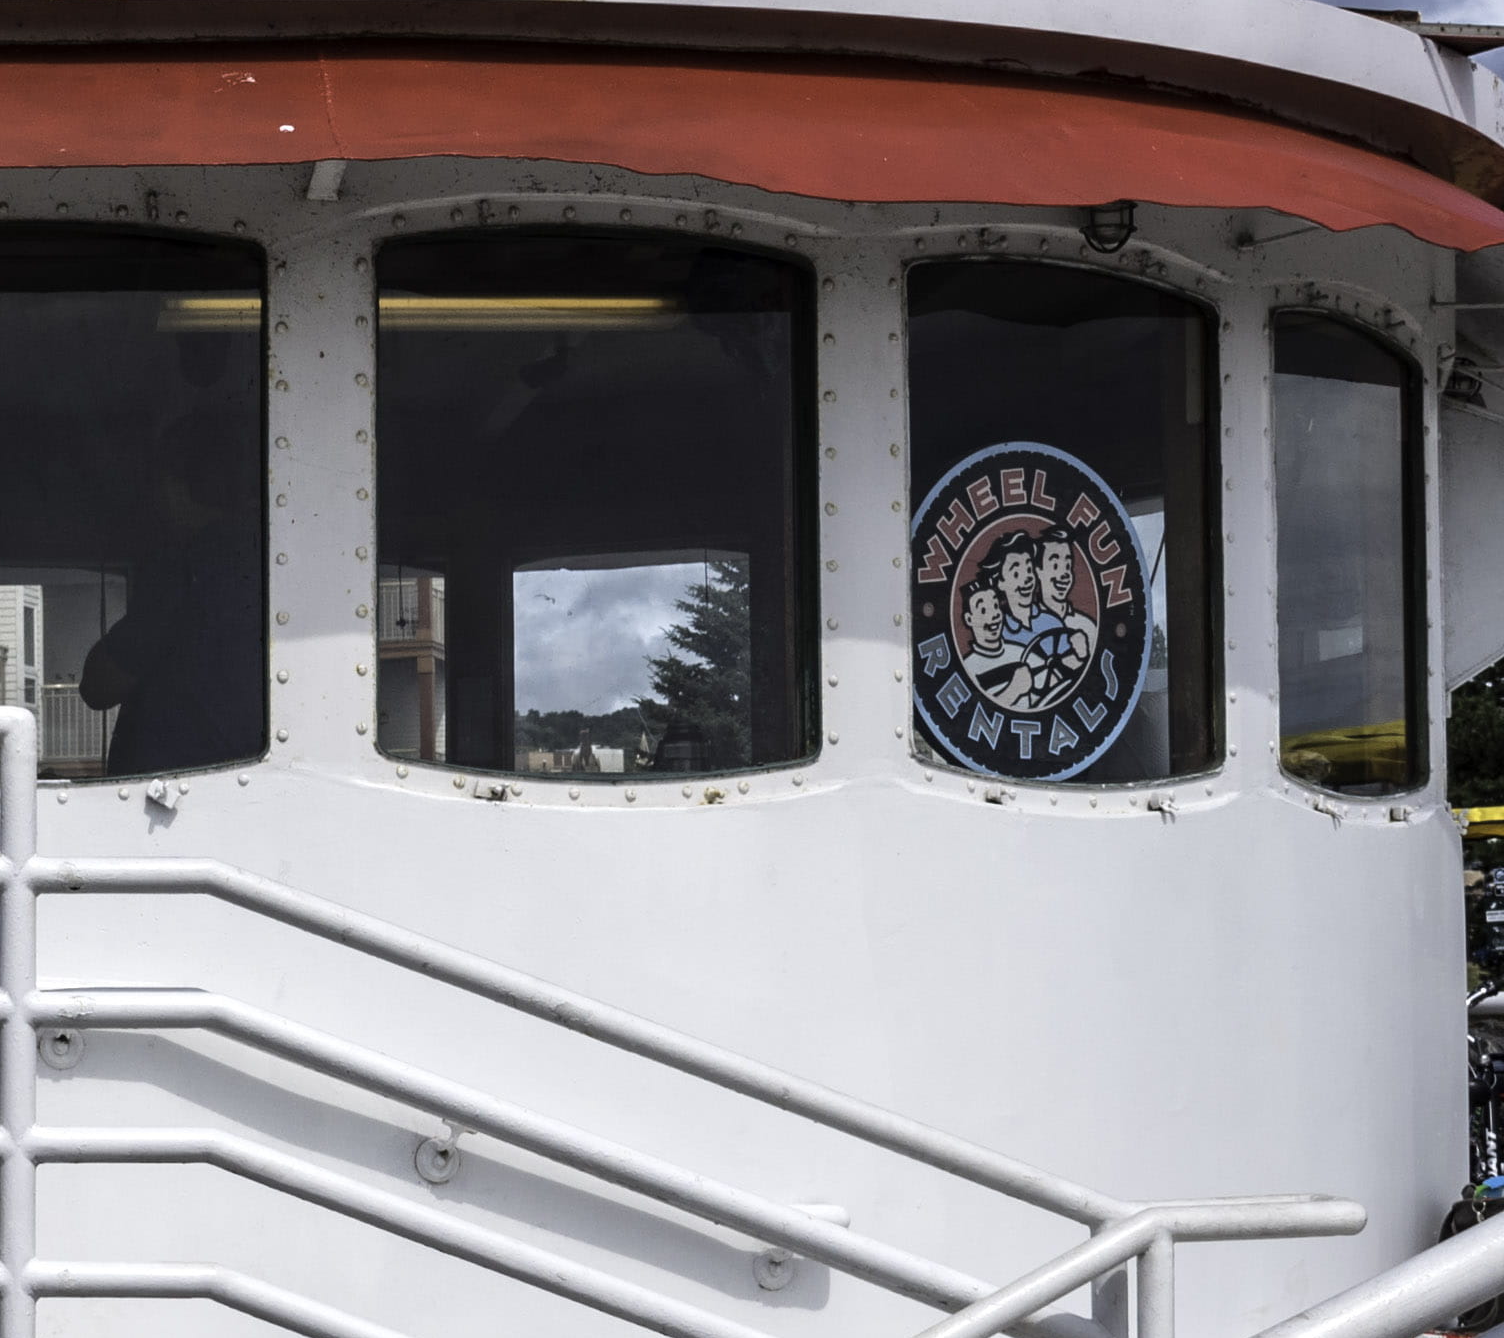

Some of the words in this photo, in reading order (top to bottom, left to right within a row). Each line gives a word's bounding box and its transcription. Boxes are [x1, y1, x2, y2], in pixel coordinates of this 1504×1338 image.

[918, 467, 1056, 583] WHEEL
[1067, 491, 1133, 608] FUN
[918, 633, 1120, 760] RENTALS
